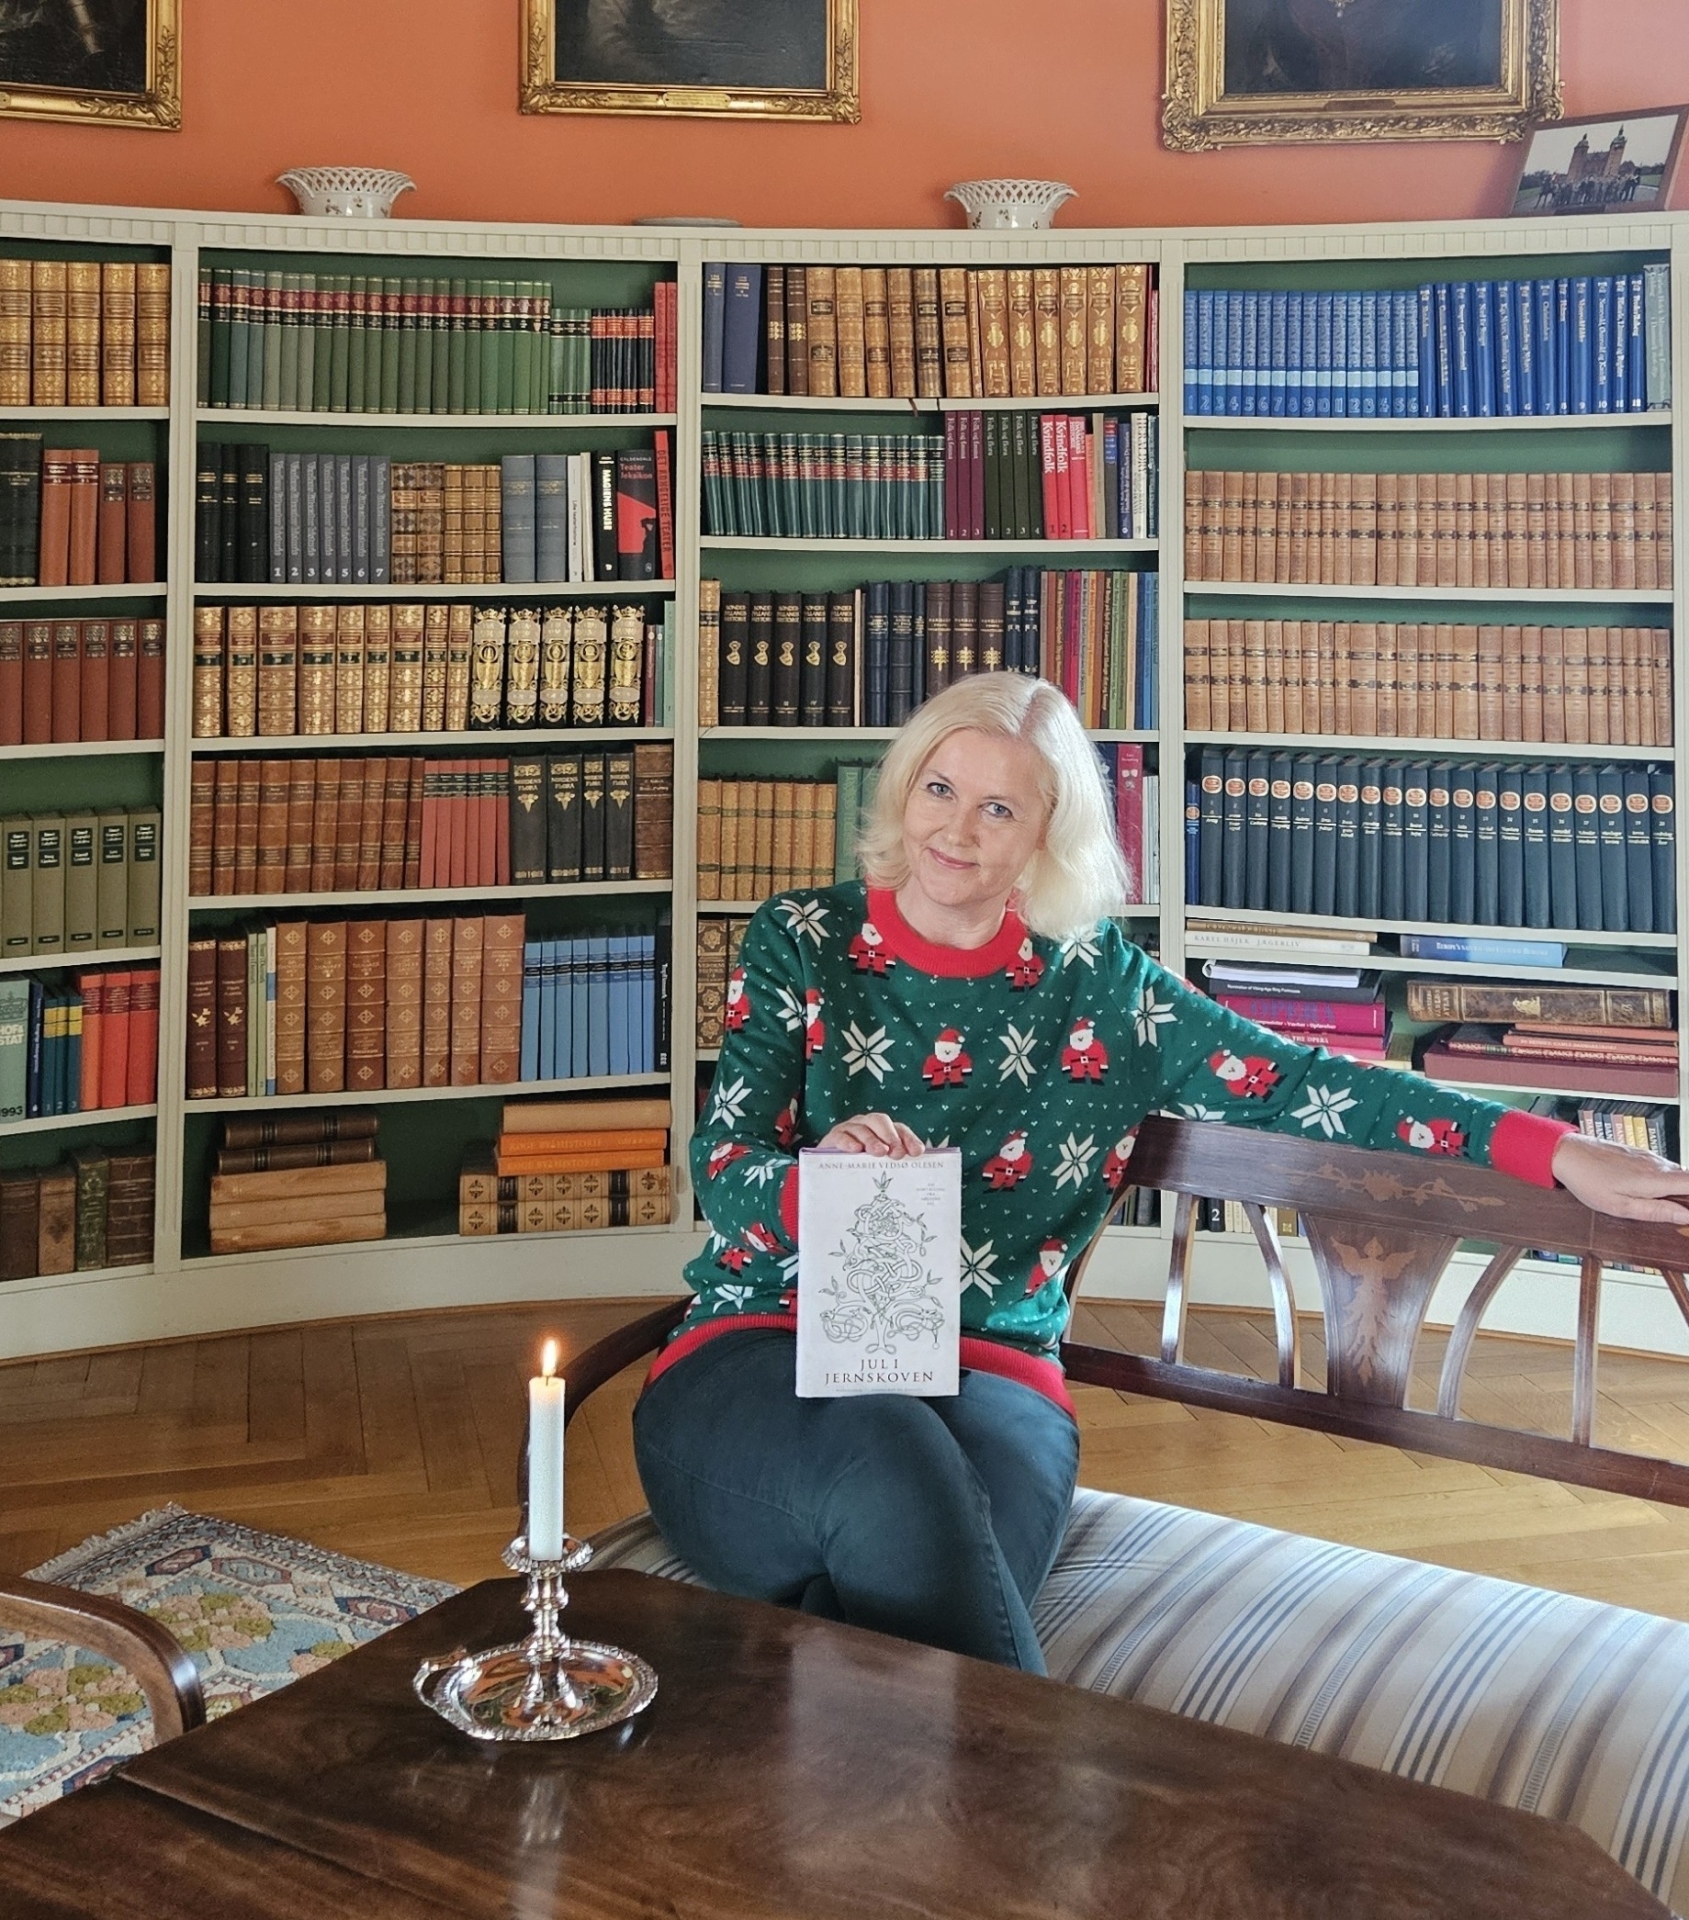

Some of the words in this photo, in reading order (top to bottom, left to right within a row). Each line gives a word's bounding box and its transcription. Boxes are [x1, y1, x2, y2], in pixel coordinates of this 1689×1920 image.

[1599, 401, 1608, 409] 10
[1042, 421, 1055, 474] Kvindfolk
[1055, 421, 1068, 473] Kvindfolk
[620, 463, 645, 472] Teater
[602, 469, 612, 507] MAGIENS
[603, 508, 613, 531] HUSE
[1061, 525, 1067, 533] 2
[662, 521, 671, 553] TEATER
[274, 568, 282, 577] 1
[291, 567, 299, 576] 2
[307, 568, 315, 577] 3
[324, 568, 333, 577] 4
[342, 568, 349, 577] 5
[358, 568, 365, 577] 6
[376, 568, 384, 577] 7
[1257, 939, 1300, 947] JÆGERLIV
[1250, 999, 1336, 1023] OPERA
[0, 1034, 24, 1046] STAT
[1307, 1036, 1329, 1044] OPERA
[819, 1162, 876, 1170] ANNE-MARIE
[879, 1161, 909, 1170] VEDSØ
[911, 1161, 944, 1169] OLESEN
[1212, 1209, 1220, 1221] 2
[861, 1359, 892, 1371] JUL
[895, 1359, 899, 1369] I
[825, 1371, 933, 1386] JERNSKOVEN
